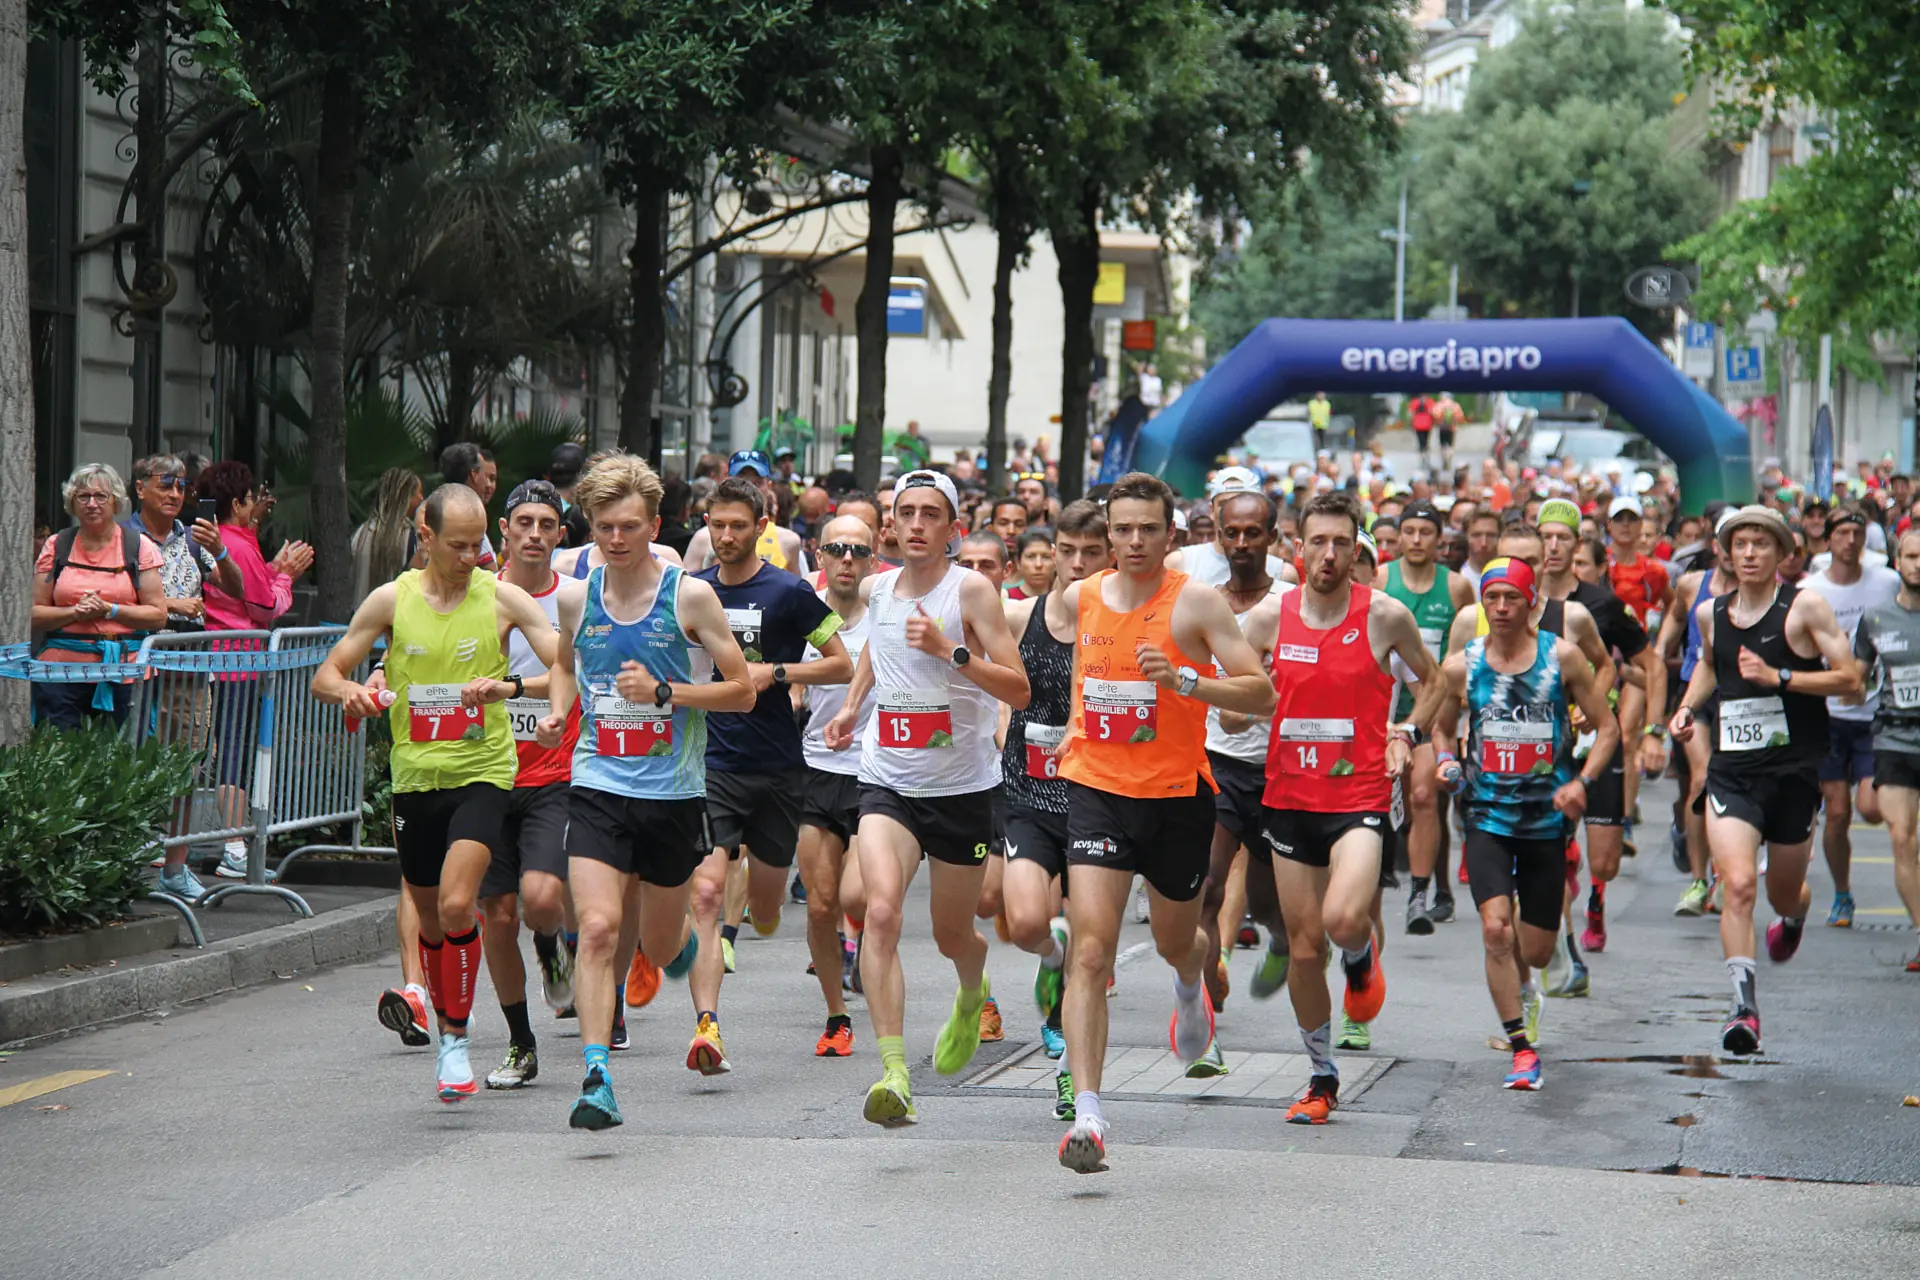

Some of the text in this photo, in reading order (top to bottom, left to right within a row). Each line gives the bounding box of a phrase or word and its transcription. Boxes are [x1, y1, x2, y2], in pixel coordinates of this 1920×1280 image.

[1340, 337, 1543, 380] energiapro
[1733, 350, 1749, 377] P
[1091, 636, 1114, 646] BCVS
[413, 707, 456, 718] FRANÇOIS
[1085, 702, 1128, 715] MAXIMILIEN
[428, 717, 441, 740] 7
[600, 720, 645, 731] THÉODORE
[890, 717, 912, 742] 15
[1099, 715, 1111, 739] 5
[1727, 722, 1763, 744] 1258
[616, 731, 626, 755] 1
[1495, 742, 1520, 751] DIEGO
[1044, 756, 1058, 778] 6
[1297, 745, 1319, 769] 14
[1497, 751, 1516, 772] 11
[1073, 840, 1092, 849] BCVS
